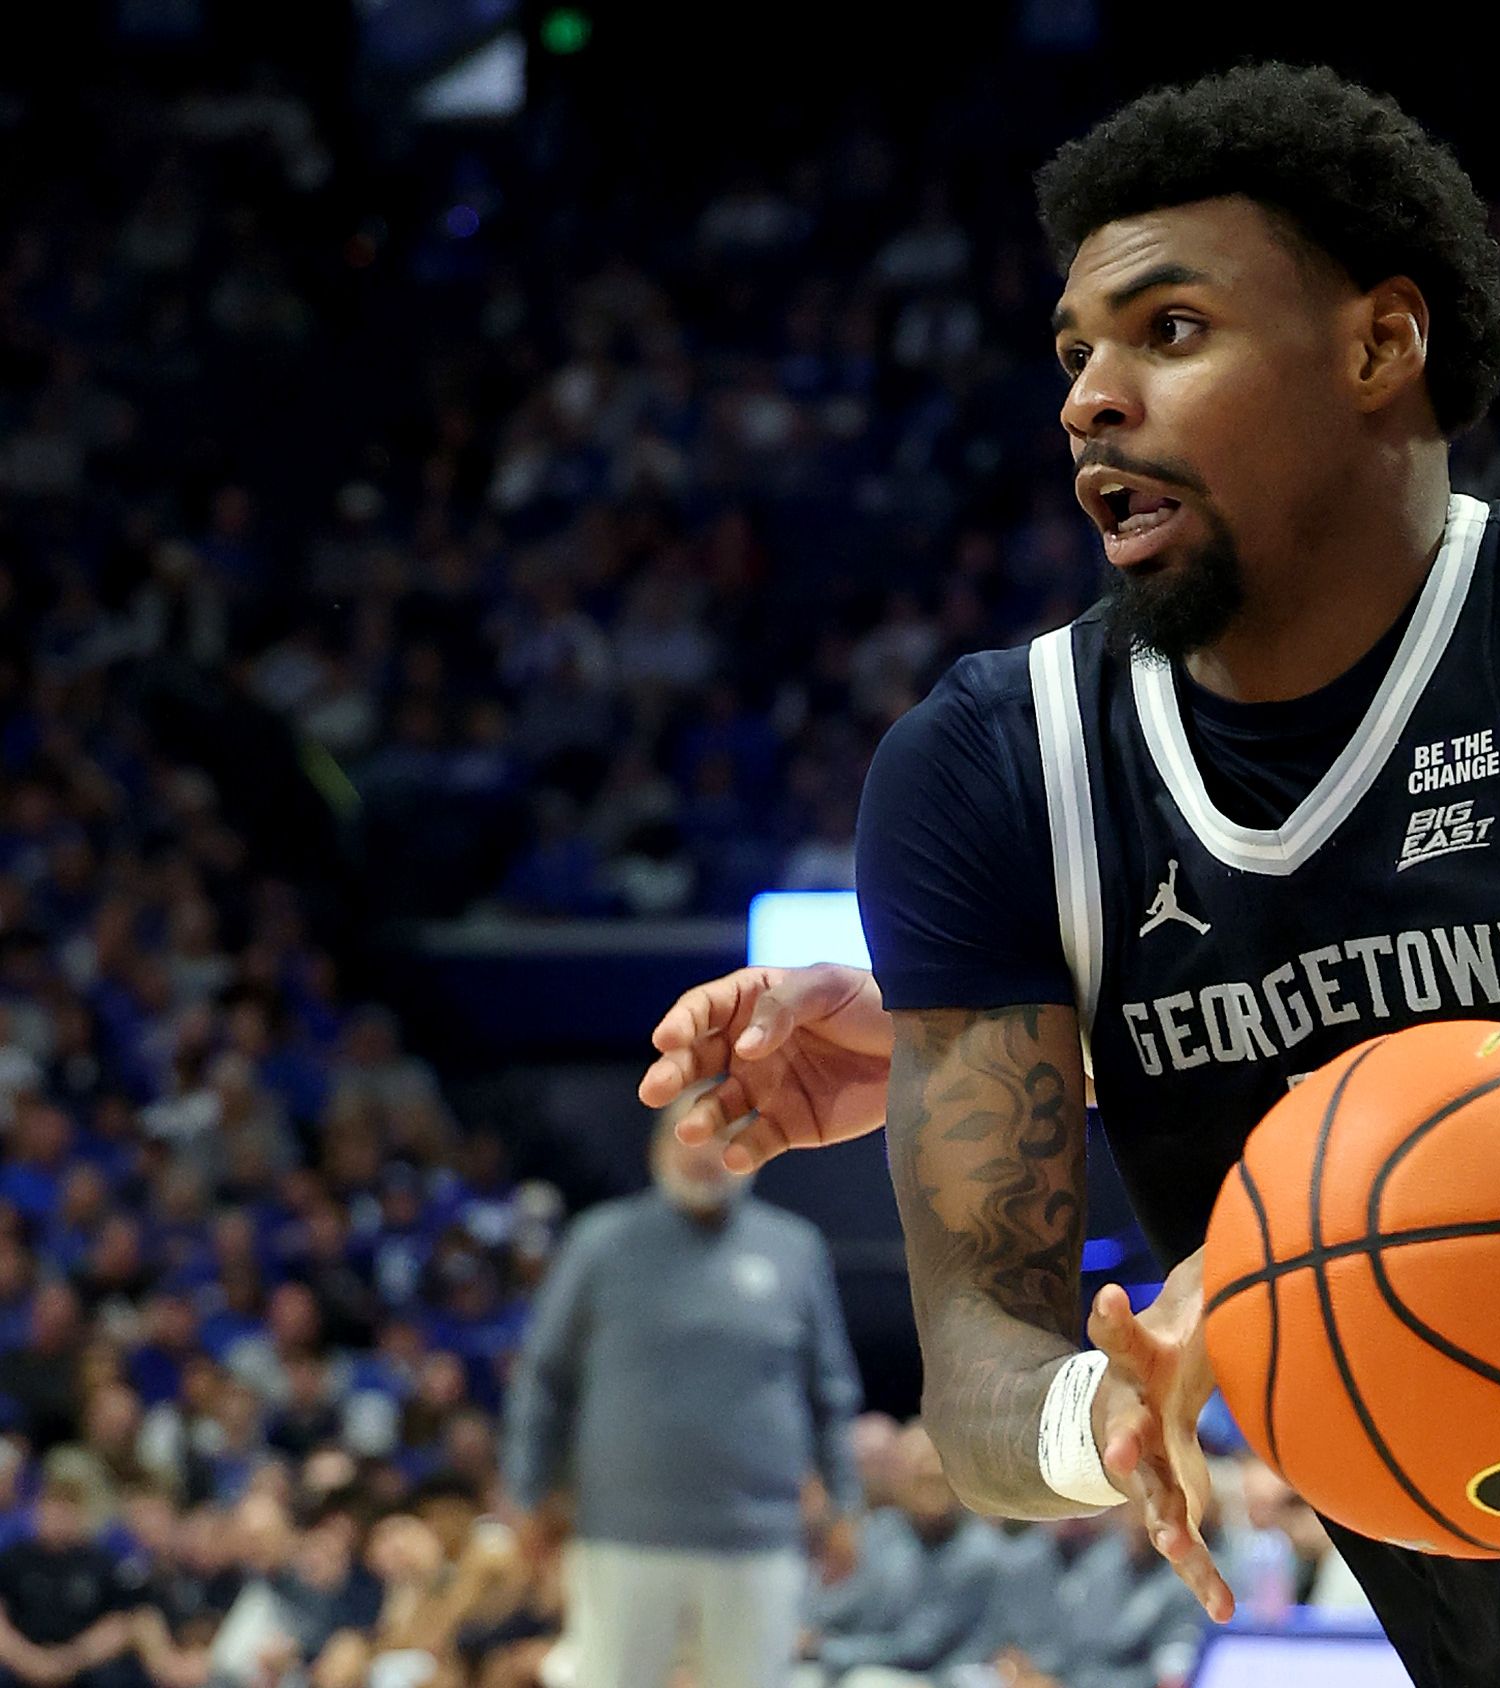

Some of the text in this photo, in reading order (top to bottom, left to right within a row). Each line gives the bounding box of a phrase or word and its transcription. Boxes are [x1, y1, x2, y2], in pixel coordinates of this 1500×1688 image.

[1414, 729, 1493, 770] BE THE
[1408, 751, 1500, 795] CHANGE
[1401, 816, 1495, 858] EAST
[1406, 800, 1475, 836] BIG
